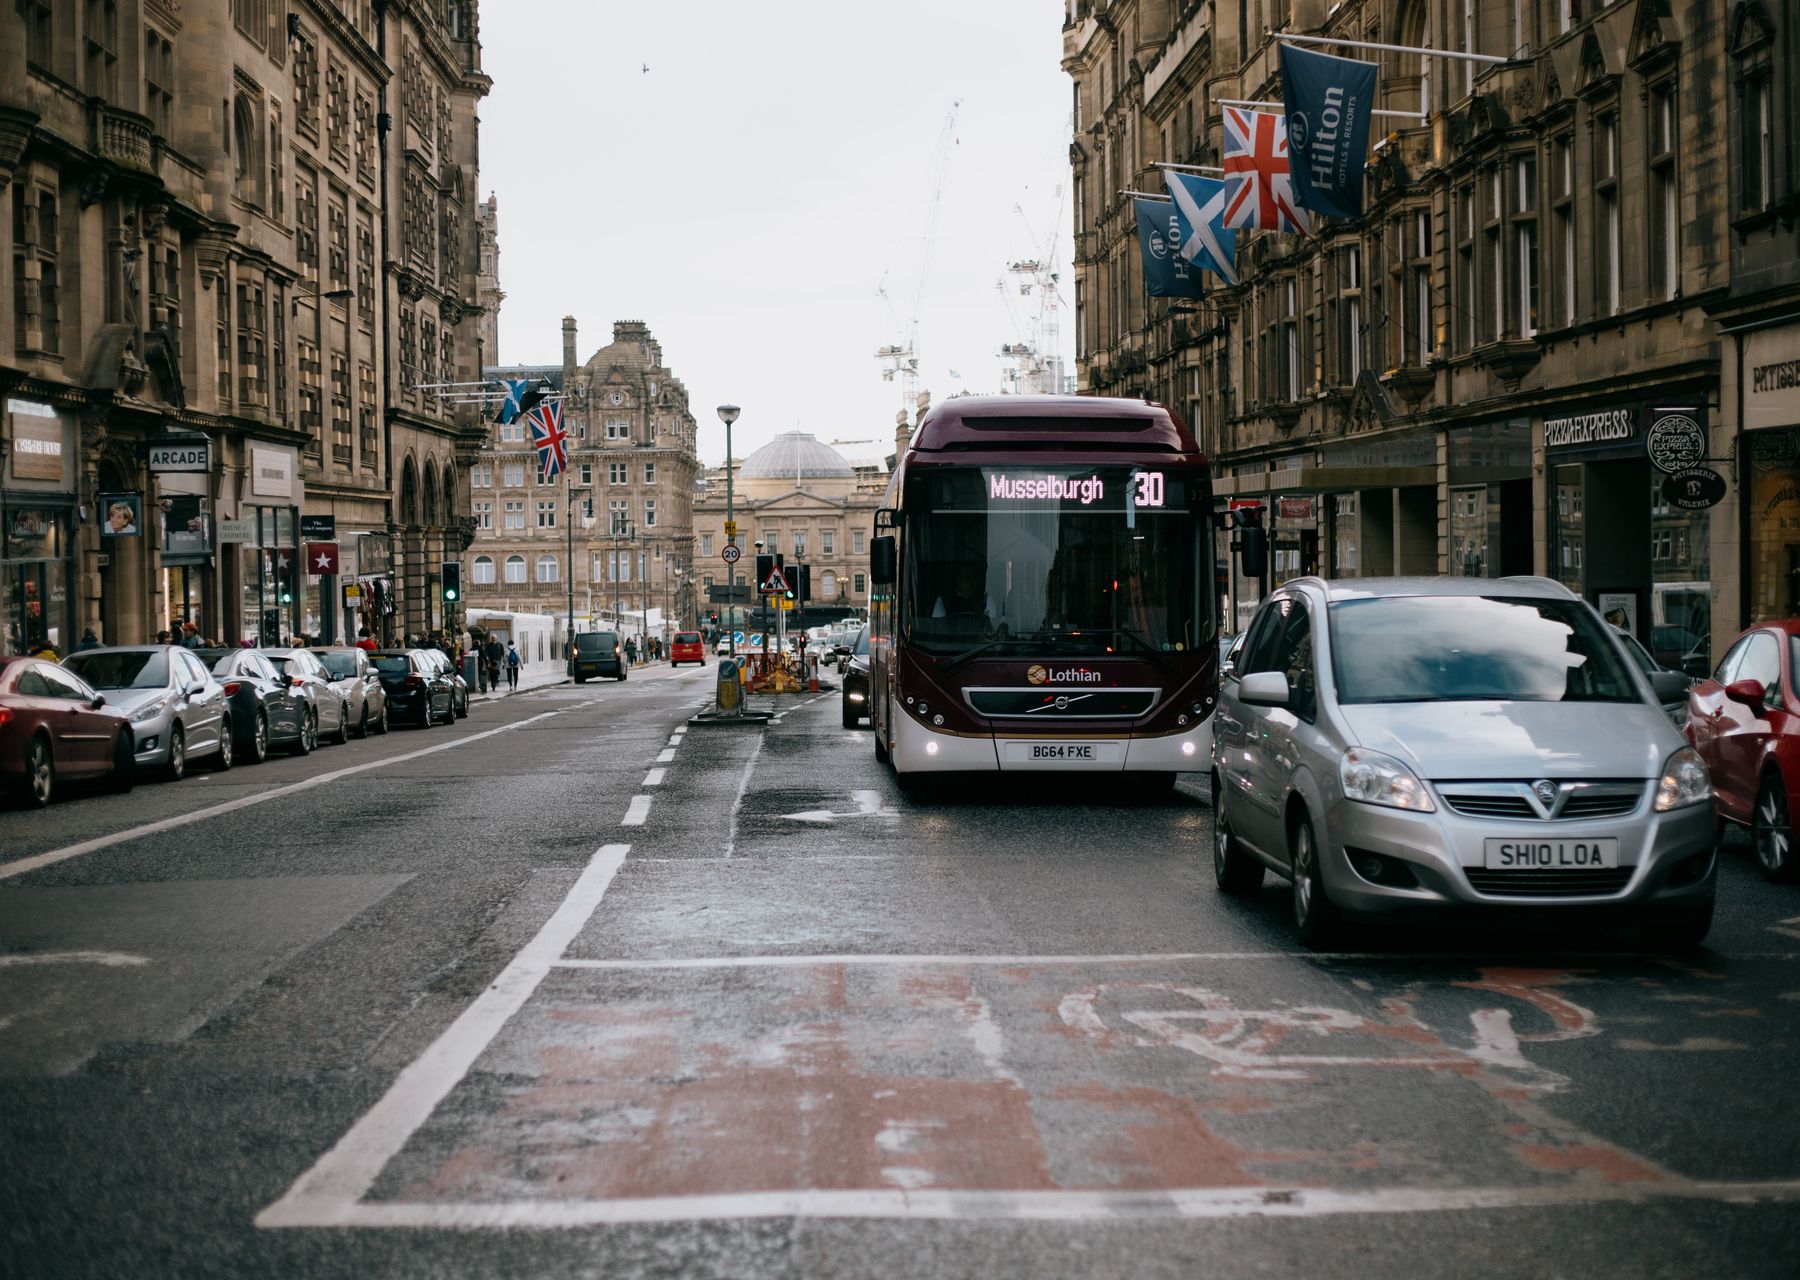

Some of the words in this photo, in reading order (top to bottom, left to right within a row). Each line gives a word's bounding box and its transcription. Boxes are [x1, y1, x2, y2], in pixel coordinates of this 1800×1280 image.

[1344, 96, 1357, 138] RESORTS
[1311, 86, 1344, 191] Hilton
[1342, 141, 1351, 151] &
[1339, 152, 1350, 187] HOTELS
[1544, 409, 1628, 447] PIZZAEXPRESS
[1661, 435, 1690, 443] PIZZA
[151, 451, 206, 465] ARCADE
[1671, 468, 1716, 481] PATISSERIE
[990, 474, 1103, 504] Musselburgh
[1134, 472, 1165, 506] 30
[1678, 498, 1711, 508] VALERIE
[724, 550, 738, 559] 20
[1048, 668, 1101, 682] Lothian
[1033, 746, 1065, 757] BG64
[1067, 746, 1092, 757] FXE
[1500, 844, 1551, 865] SH10
[1559, 844, 1603, 865] LOA
